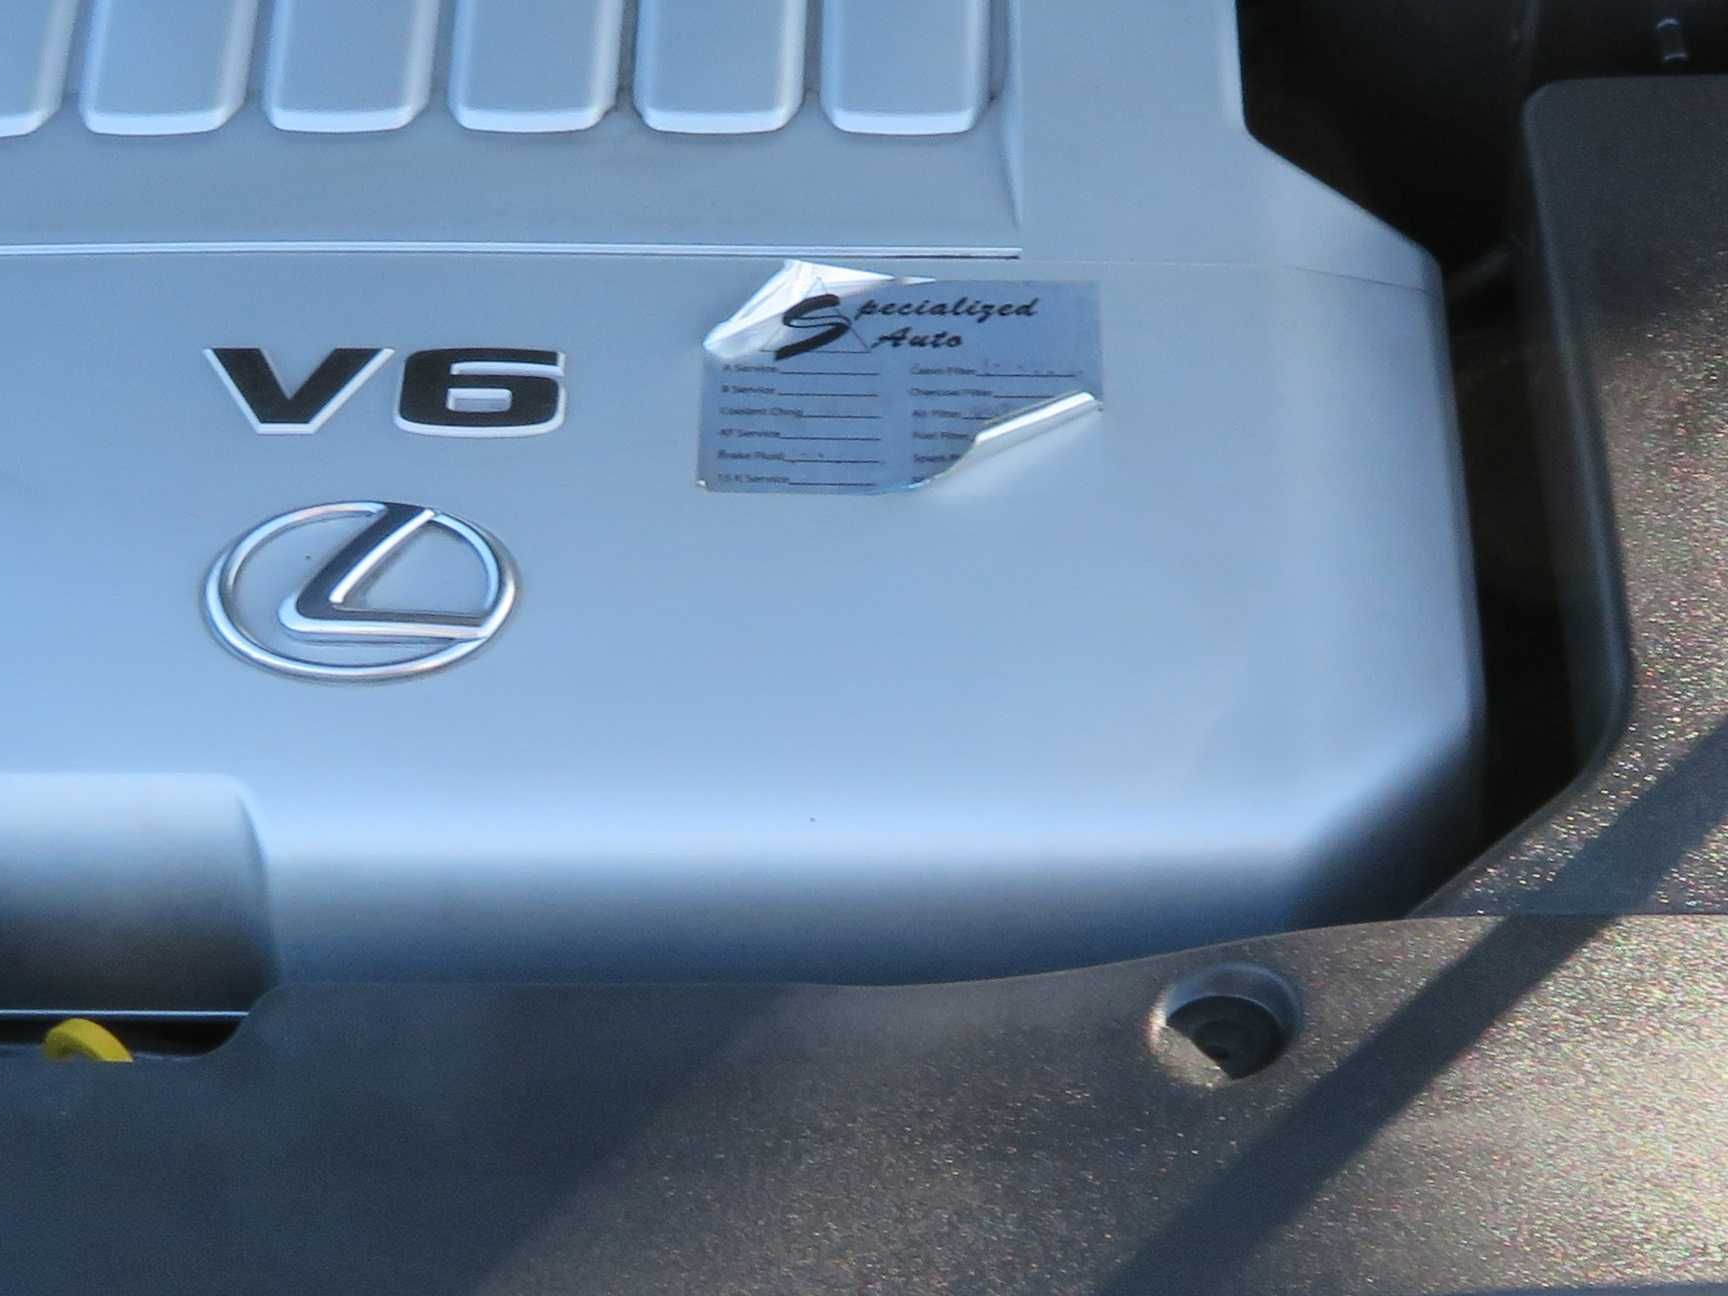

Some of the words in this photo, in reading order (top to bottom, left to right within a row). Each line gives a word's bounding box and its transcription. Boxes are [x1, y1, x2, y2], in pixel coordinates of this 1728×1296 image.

[775, 293, 1040, 361] Specialized
[871, 326, 963, 349] Auto
[202, 346, 567, 438] V6
